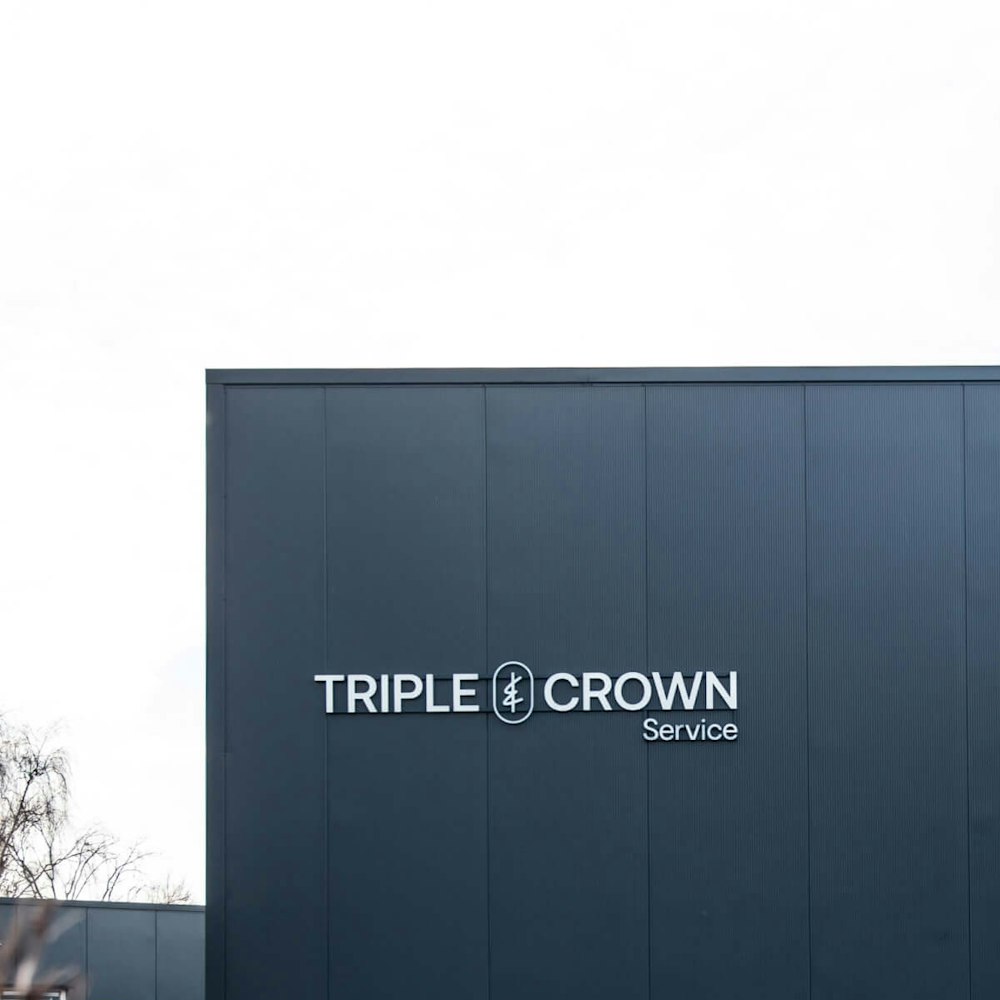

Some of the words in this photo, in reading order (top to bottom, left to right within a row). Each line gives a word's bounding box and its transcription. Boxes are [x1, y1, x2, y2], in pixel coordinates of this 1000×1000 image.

[314, 674, 480, 713] TRIPLE
[543, 670, 738, 712] CROWN
[642, 718, 738, 741] Service
